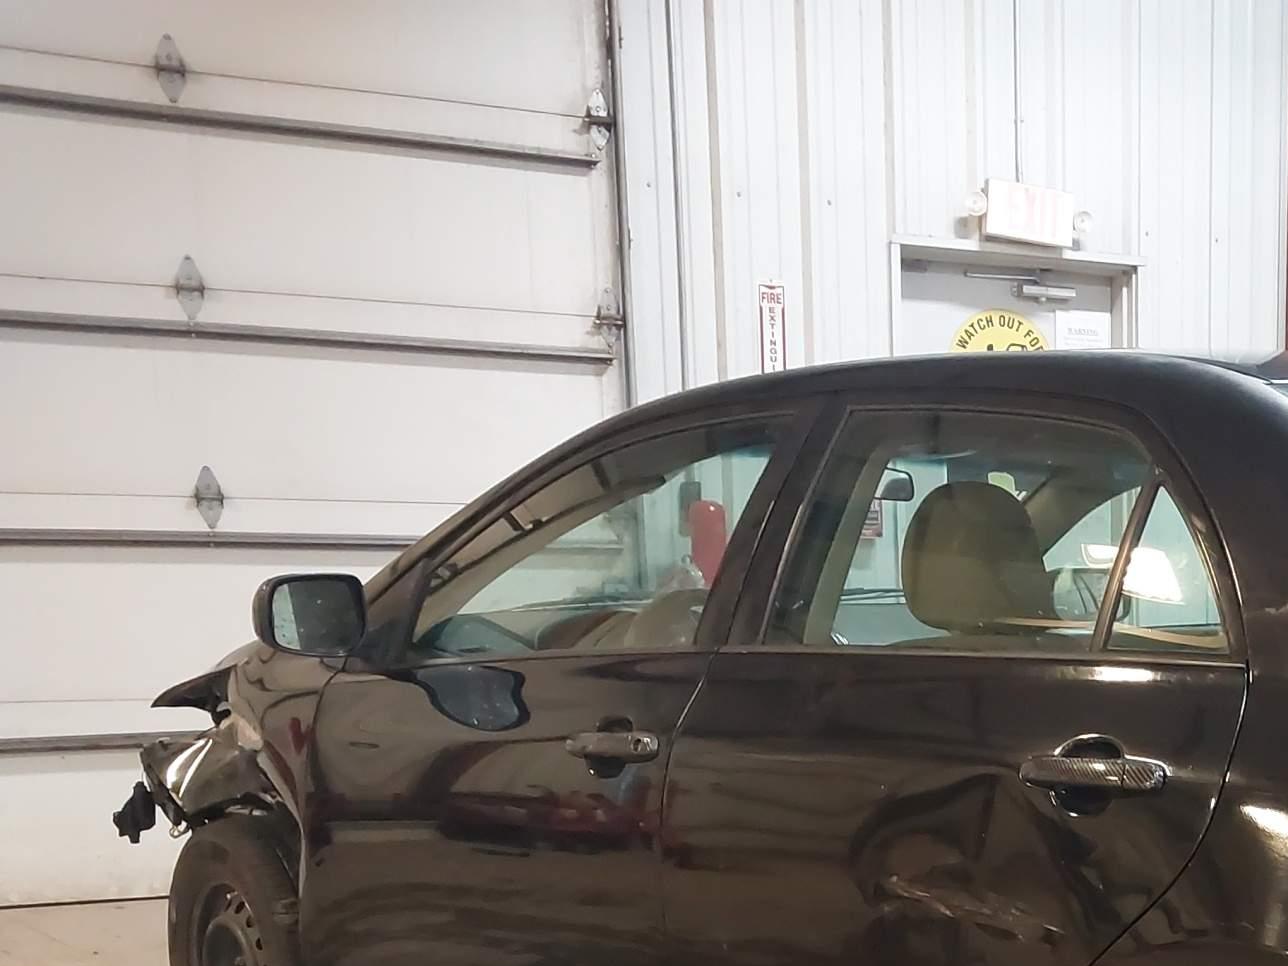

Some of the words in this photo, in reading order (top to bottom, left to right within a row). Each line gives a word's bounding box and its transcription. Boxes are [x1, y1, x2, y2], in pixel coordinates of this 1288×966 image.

[761, 292, 783, 305] FIRE
[956, 314, 995, 350] WATCH
[998, 314, 1024, 332] OUT
